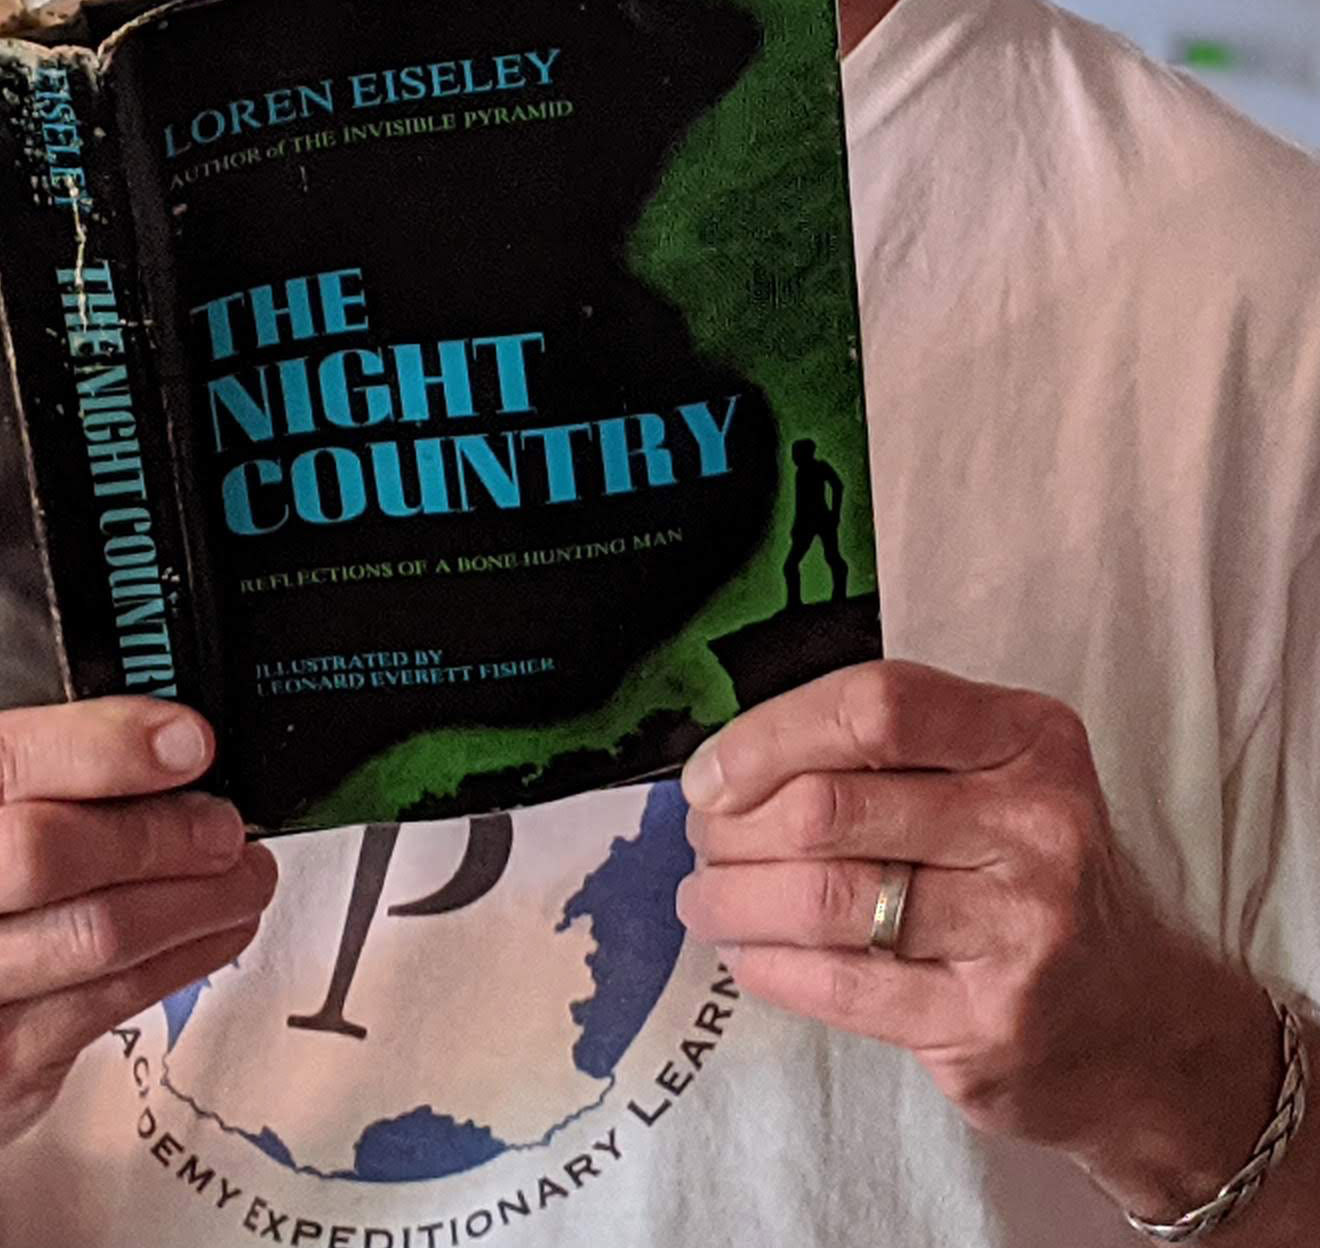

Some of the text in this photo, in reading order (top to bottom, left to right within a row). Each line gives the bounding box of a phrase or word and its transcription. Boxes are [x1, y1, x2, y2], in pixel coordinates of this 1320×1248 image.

[164, 48, 561, 158] LOREN EISELEY
[169, 100, 573, 190] AUTHOR of THE INVISIBLE PYRAMID
[189, 268, 370, 361] THE
[207, 331, 545, 452] NIGHT
[55, 259, 178, 697] THE NIGHT COUNTR
[221, 394, 742, 536] COUNTRY
[240, 560, 394, 594] REFLECTIONS
[398, 558, 428, 576] OF
[435, 557, 452, 574] A
[633, 527, 683, 551] MAN
[256, 649, 443, 680] ILLUSTRATED BY
[256, 655, 555, 697] LEONARD EVERETT FISHER
[112, 1027, 242, 1208] ACDEMY
[242, 1127, 623, 1248] EXPEDITIONARY
